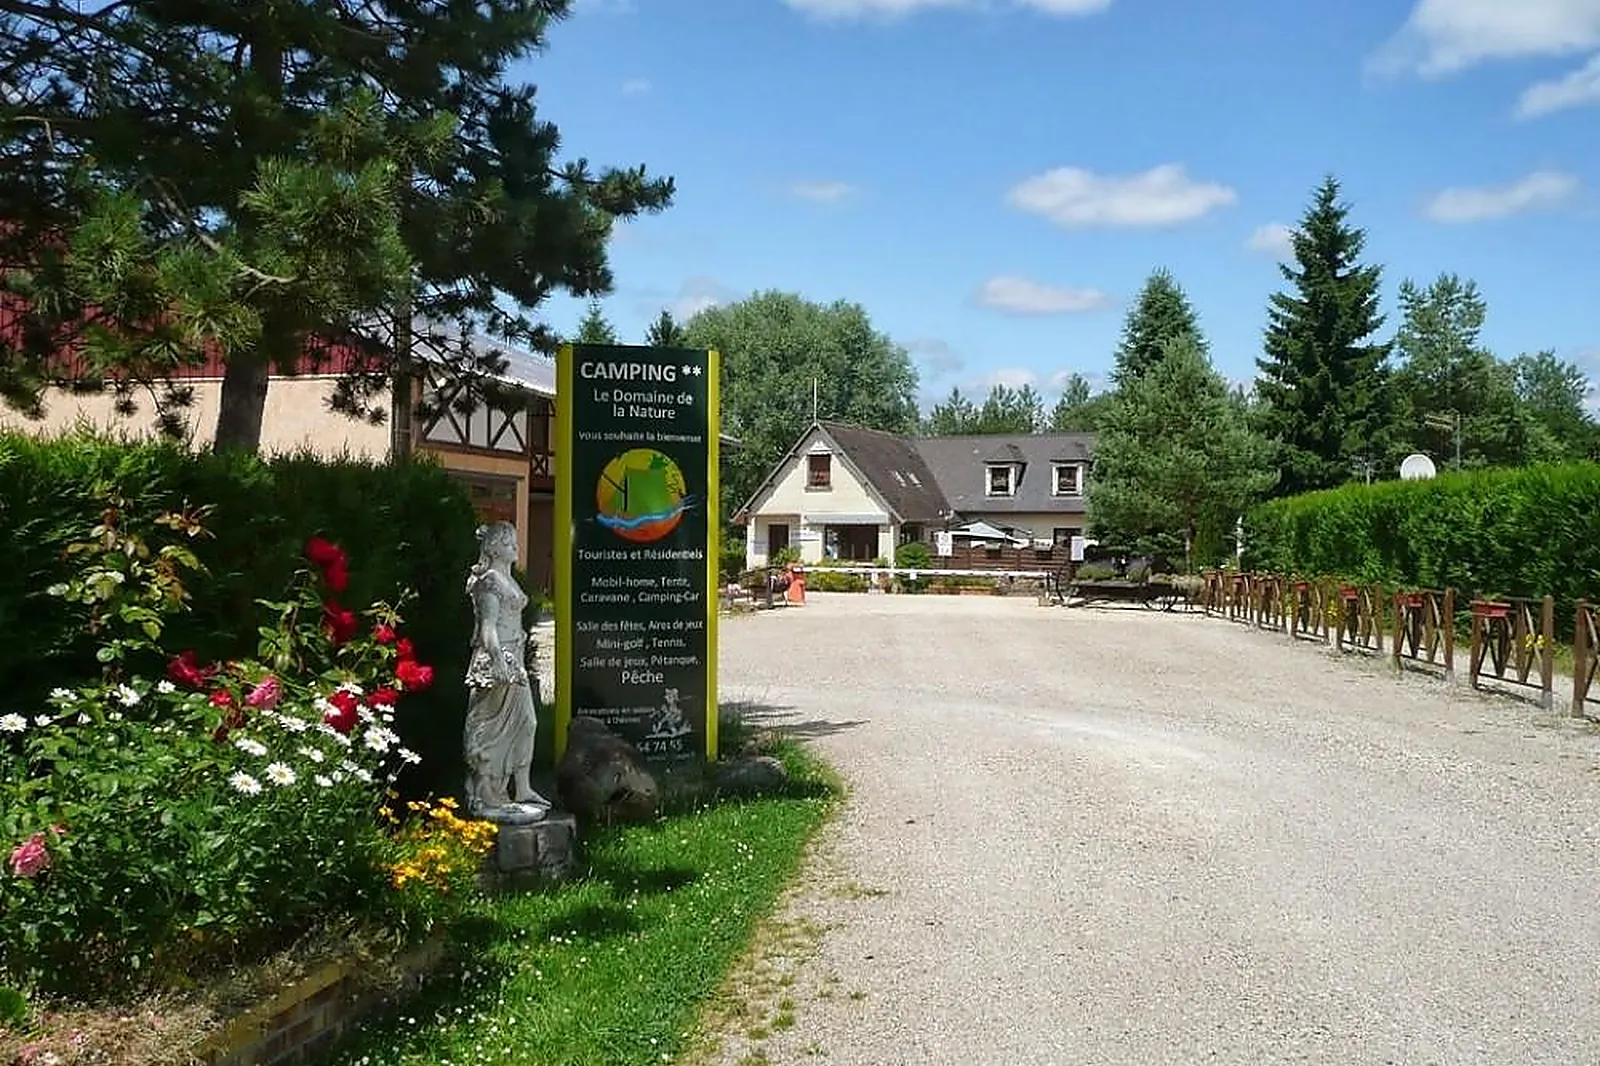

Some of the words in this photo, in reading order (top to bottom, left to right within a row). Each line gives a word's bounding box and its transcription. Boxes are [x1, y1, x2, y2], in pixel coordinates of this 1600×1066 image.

[580, 361, 677, 382] CAMPING
[594, 388, 609, 402] Le
[613, 389, 675, 404] Domaine
[677, 391, 693, 405] de
[613, 404, 625, 417] la
[629, 405, 676, 419] Nature
[578, 549, 628, 560] Touristes
[630, 549, 640, 560] et
[576, 620, 599, 631] Salle
[600, 620, 619, 631] des
[648, 620, 671, 630] Aires
[672, 619, 684, 630] de
[684, 620, 703, 631] jeux
[579, 656, 605, 669] Salle
[608, 656, 621, 668] de
[621, 668, 664, 685] Pêche
